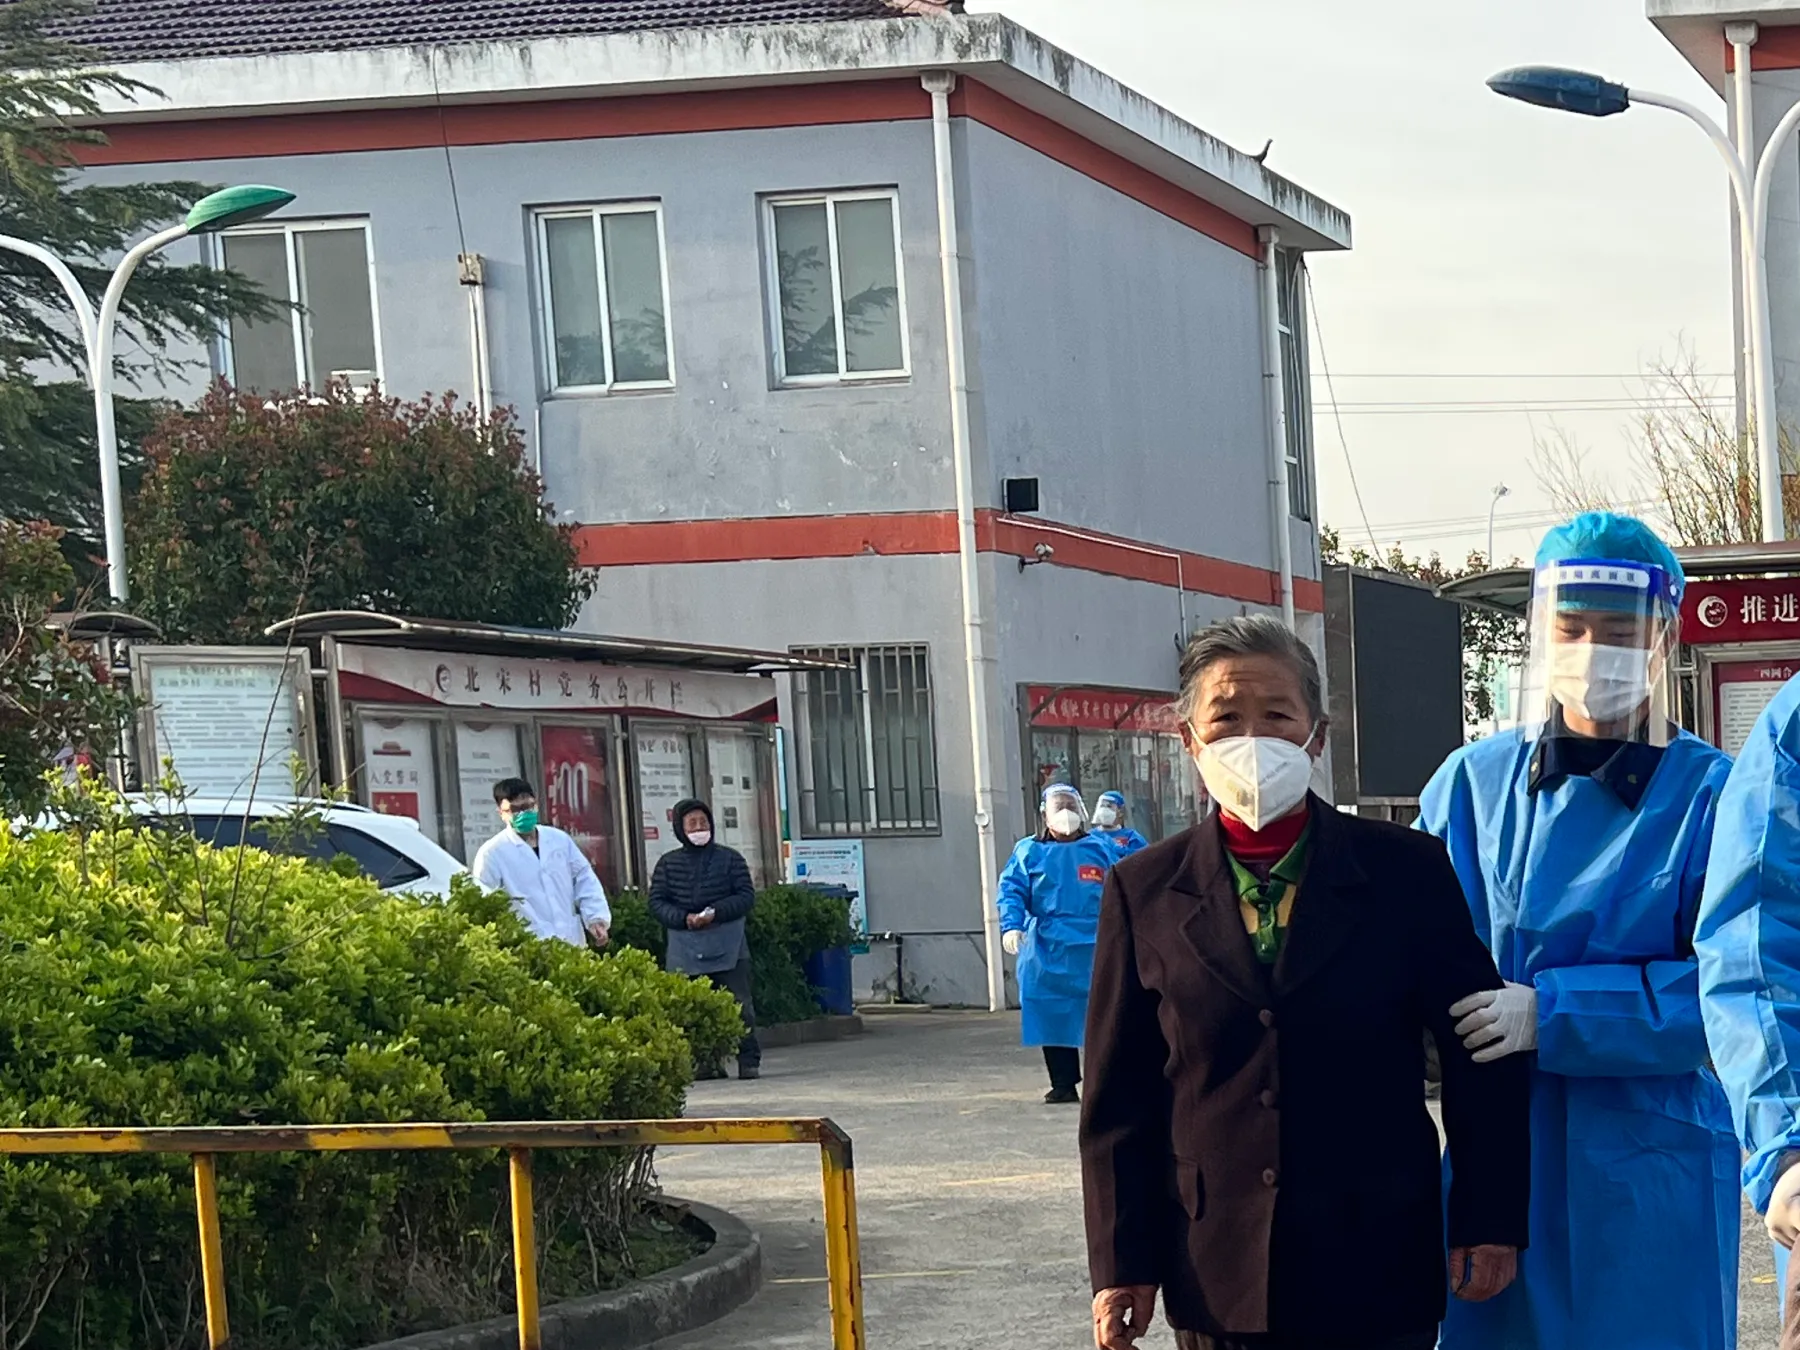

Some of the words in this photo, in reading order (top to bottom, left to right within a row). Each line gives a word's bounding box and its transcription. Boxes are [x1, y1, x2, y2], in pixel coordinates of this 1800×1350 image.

[464, 665, 684, 706] 北宋村党务公开栏
